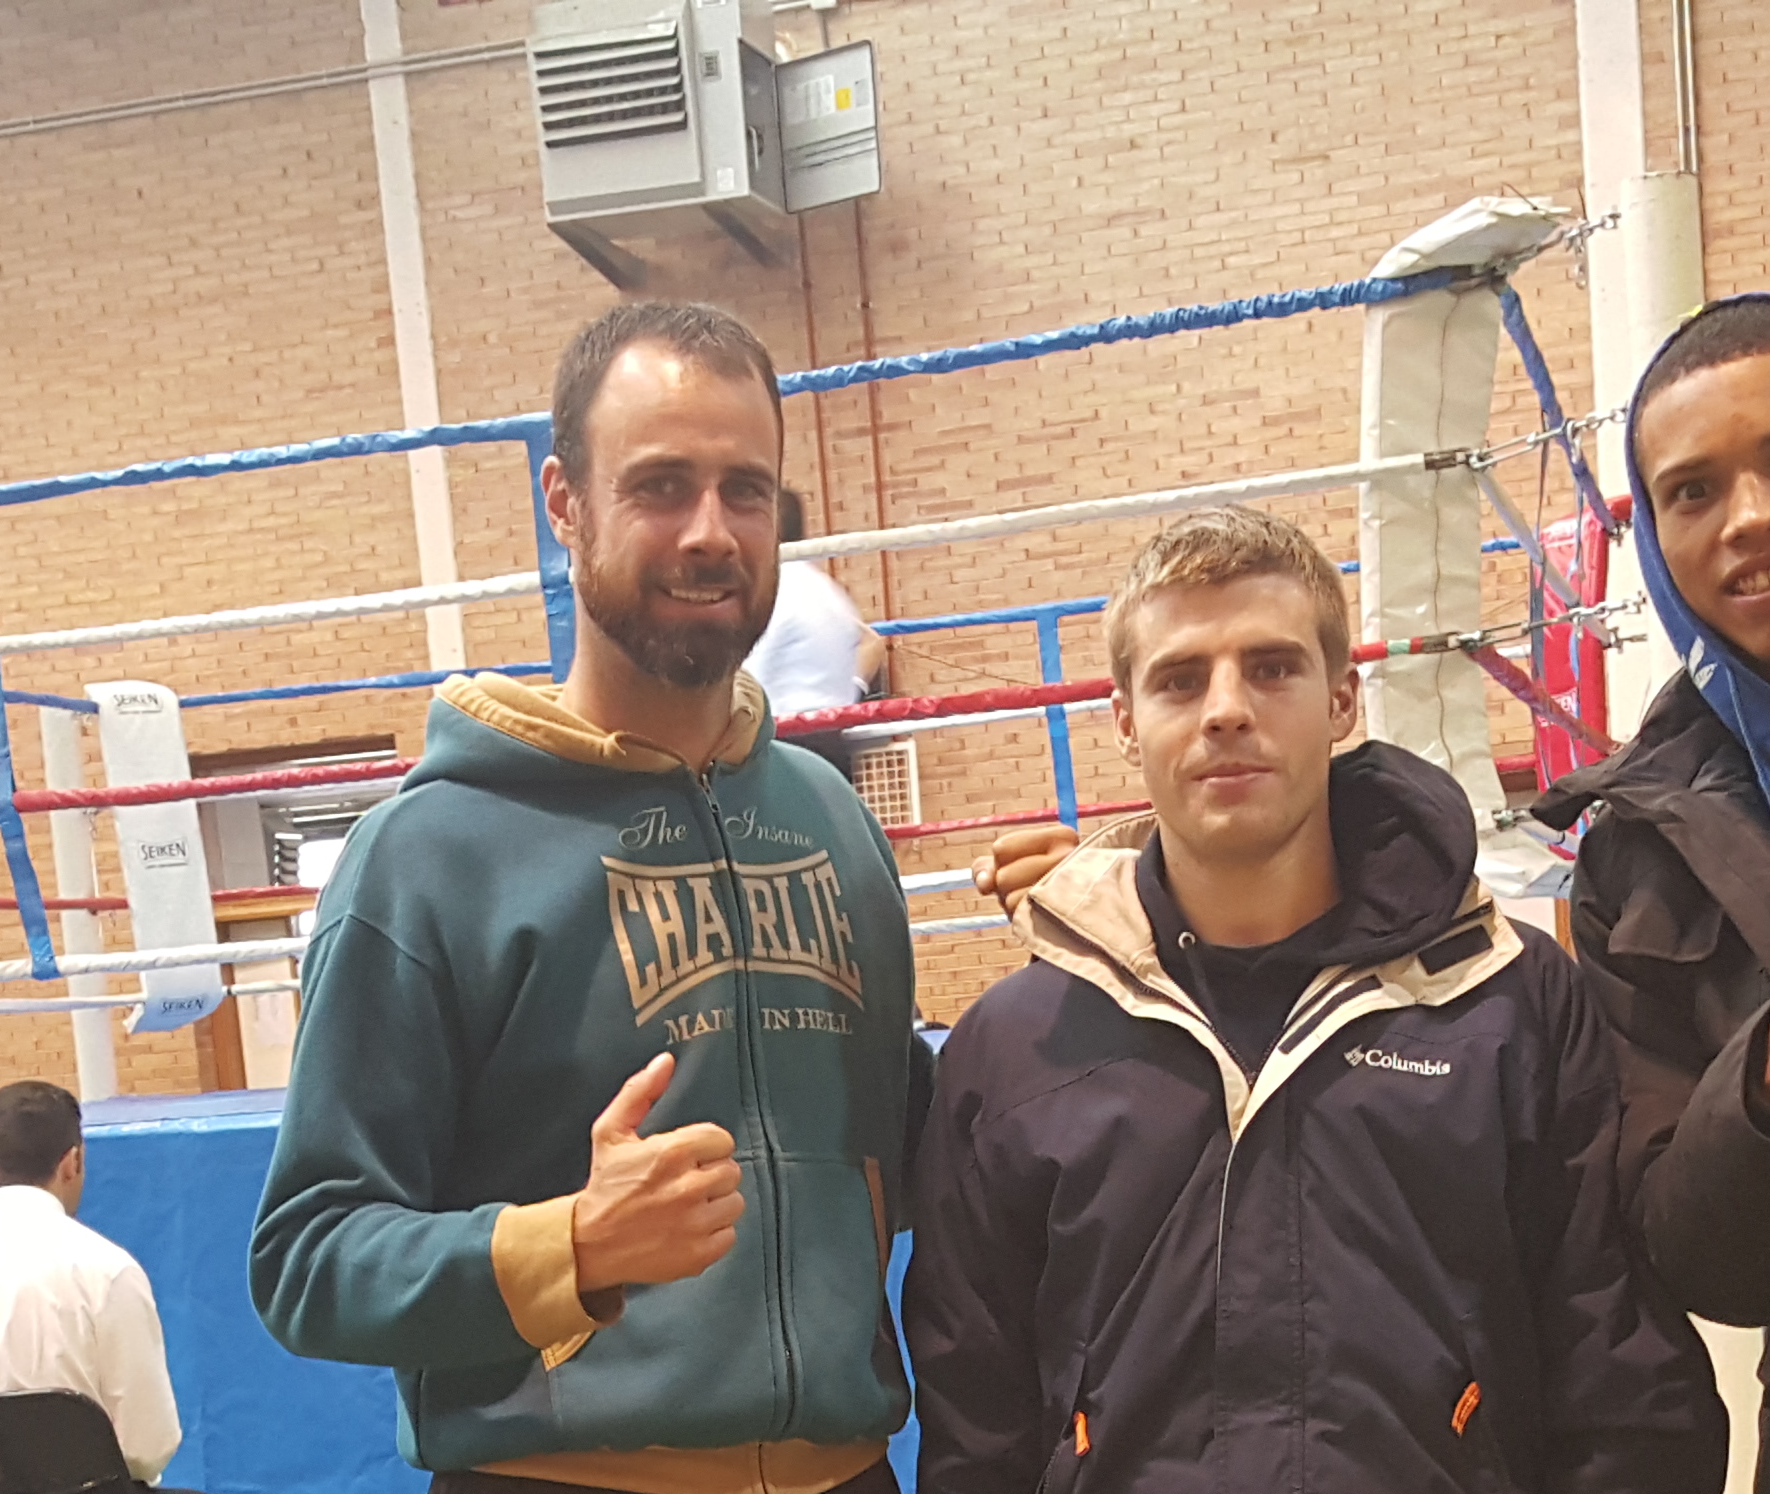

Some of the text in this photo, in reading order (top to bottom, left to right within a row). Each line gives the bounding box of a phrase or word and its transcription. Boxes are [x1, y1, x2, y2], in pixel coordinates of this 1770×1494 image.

[114, 692, 160, 708] SEIKEN
[619, 806, 815, 850] The Insane
[140, 841, 187, 861] SEIKEN
[607, 857, 863, 1012] CHARLIE
[762, 1007, 791, 1031] IN
[795, 1006, 853, 1036] HELL
[1365, 1048, 1452, 1076] Columbia
